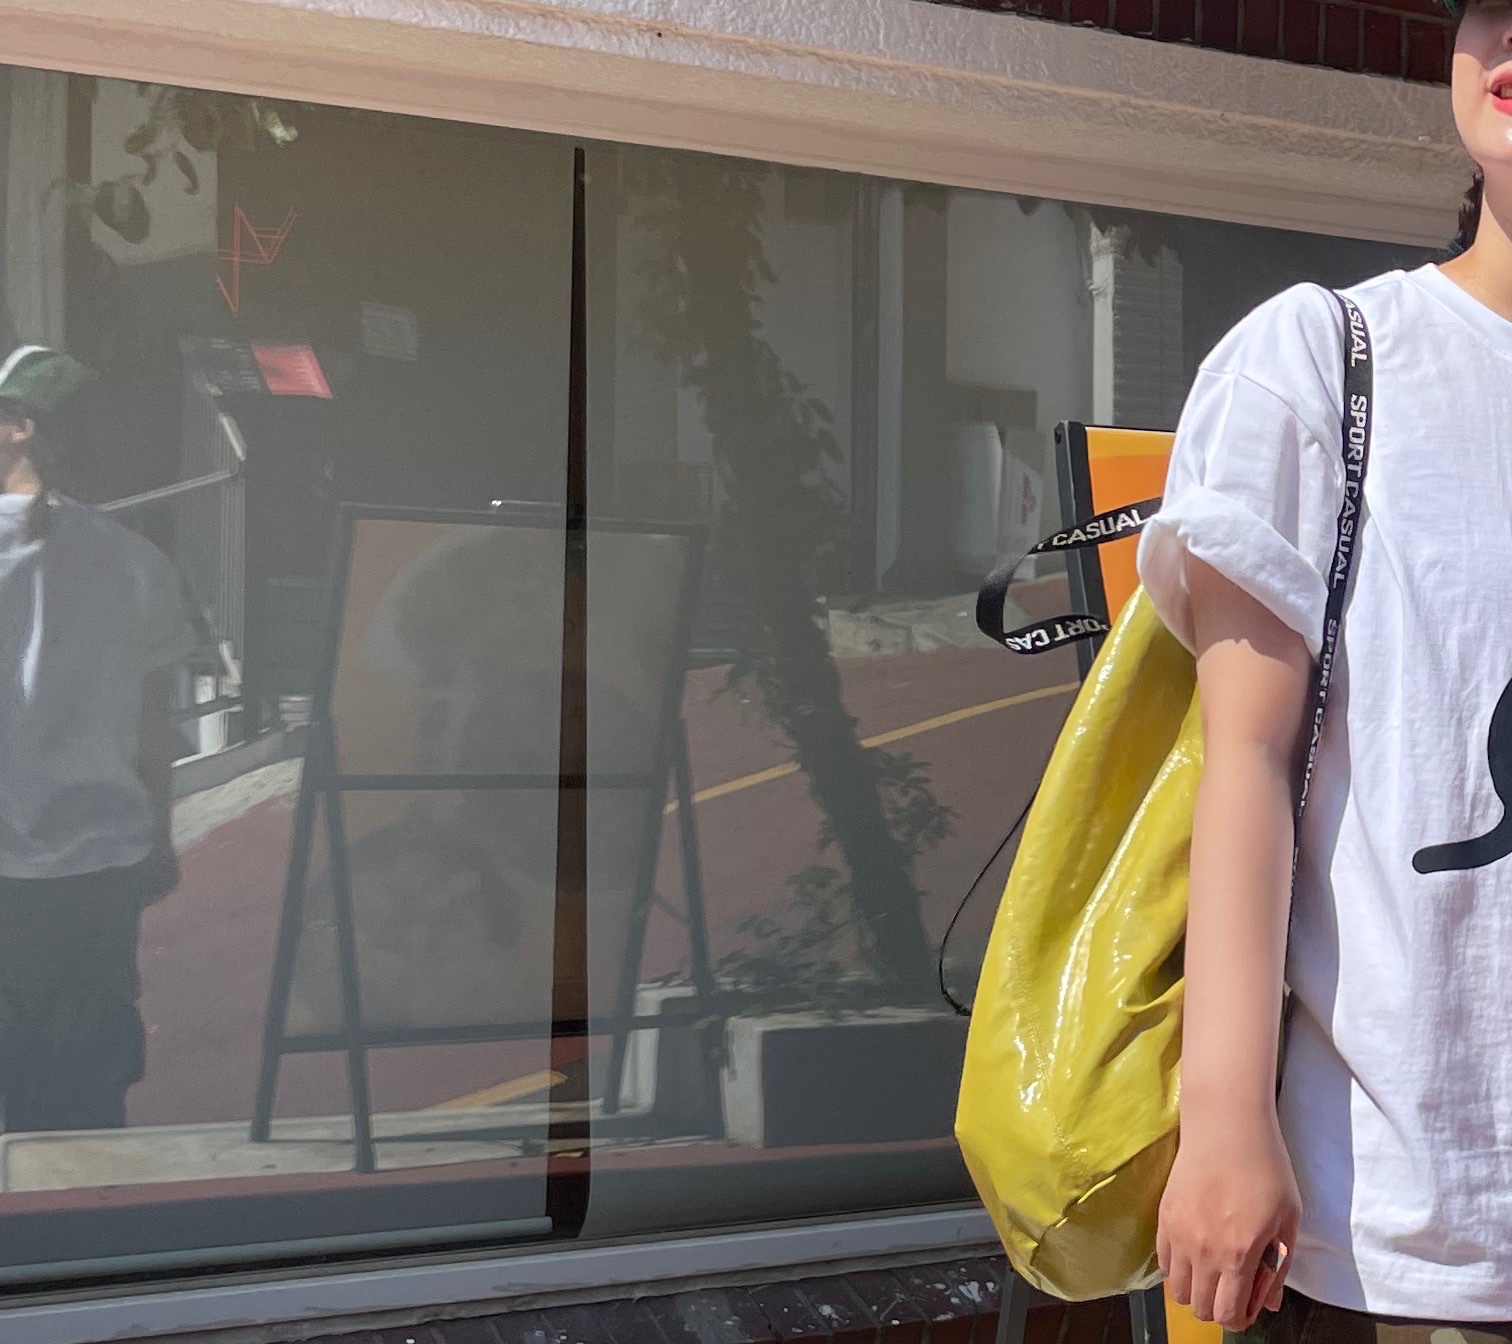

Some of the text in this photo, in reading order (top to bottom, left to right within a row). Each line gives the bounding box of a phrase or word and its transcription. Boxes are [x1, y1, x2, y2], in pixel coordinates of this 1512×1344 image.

[1342, 294, 1368, 368] ASUAL
[1348, 395, 1368, 477] SPORT
[1052, 508, 1151, 547] CASUAL
[1333, 479, 1359, 589] CASUAL
[1054, 618, 1108, 642] ORT
